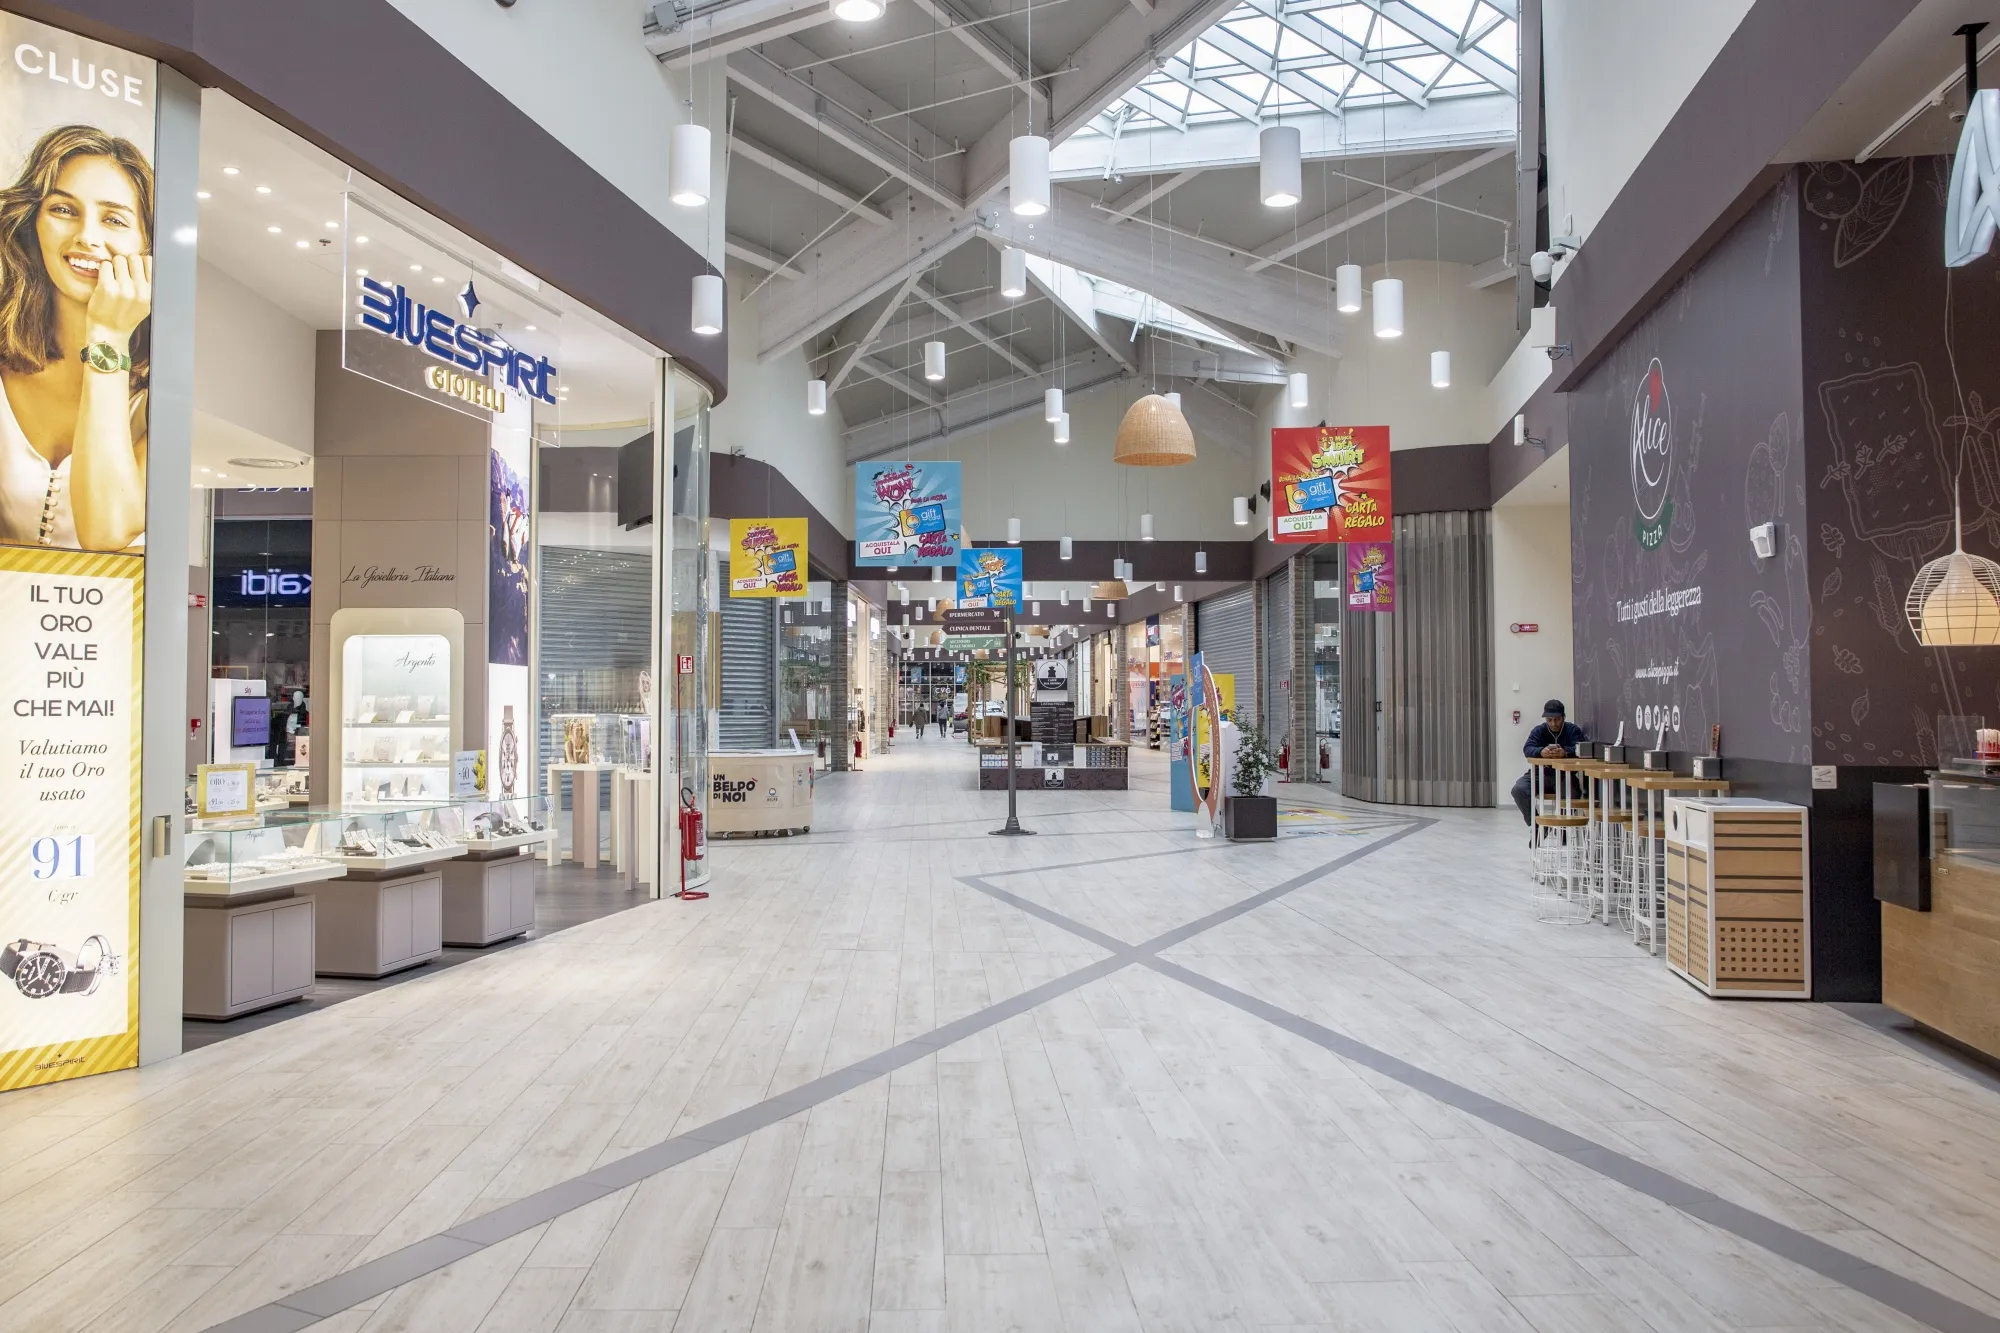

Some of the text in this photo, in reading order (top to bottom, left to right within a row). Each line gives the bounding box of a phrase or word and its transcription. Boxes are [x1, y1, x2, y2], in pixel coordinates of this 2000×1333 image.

[15, 43, 143, 107] CLUSE
[428, 366, 505, 413] GIOIELLI
[1311, 449, 1365, 468] SMART
[876, 478, 913, 501] WOW
[1309, 481, 1326, 496] gift
[920, 508, 936, 521] gift
[1345, 499, 1377, 514] CARTA
[1283, 514, 1323, 524] ACQUISTALA
[1293, 521, 1313, 531] QUI
[1344, 515, 1385, 529] REGALO
[919, 531, 947, 544] CARTA
[1642, 524, 1663, 547] PIZZA
[777, 553, 790, 563] gift
[874, 547, 892, 555] QUI
[918, 545, 953, 558] REGALO
[342, 566, 456, 588] La Gioielleria Italiana
[30, 585, 104, 606] IL TUO
[1616, 599, 1631, 622] Tutti
[1634, 594, 1648, 624] gusti
[1648, 589, 1664, 615] della
[1665, 586, 1701, 616] leggerezza
[40, 614, 93, 632] ORO
[34, 642, 98, 661] VALE
[393, 652, 437, 673] Argento
[47, 666, 85, 689] PIÙ
[13, 699, 114, 717] CHE MAI!
[19, 739, 108, 756] Valutiamo
[20, 761, 105, 779] il tuo Oro
[40, 788, 86, 801] usato
[723, 792, 746, 803] NOI
[32, 835, 87, 880] 91
